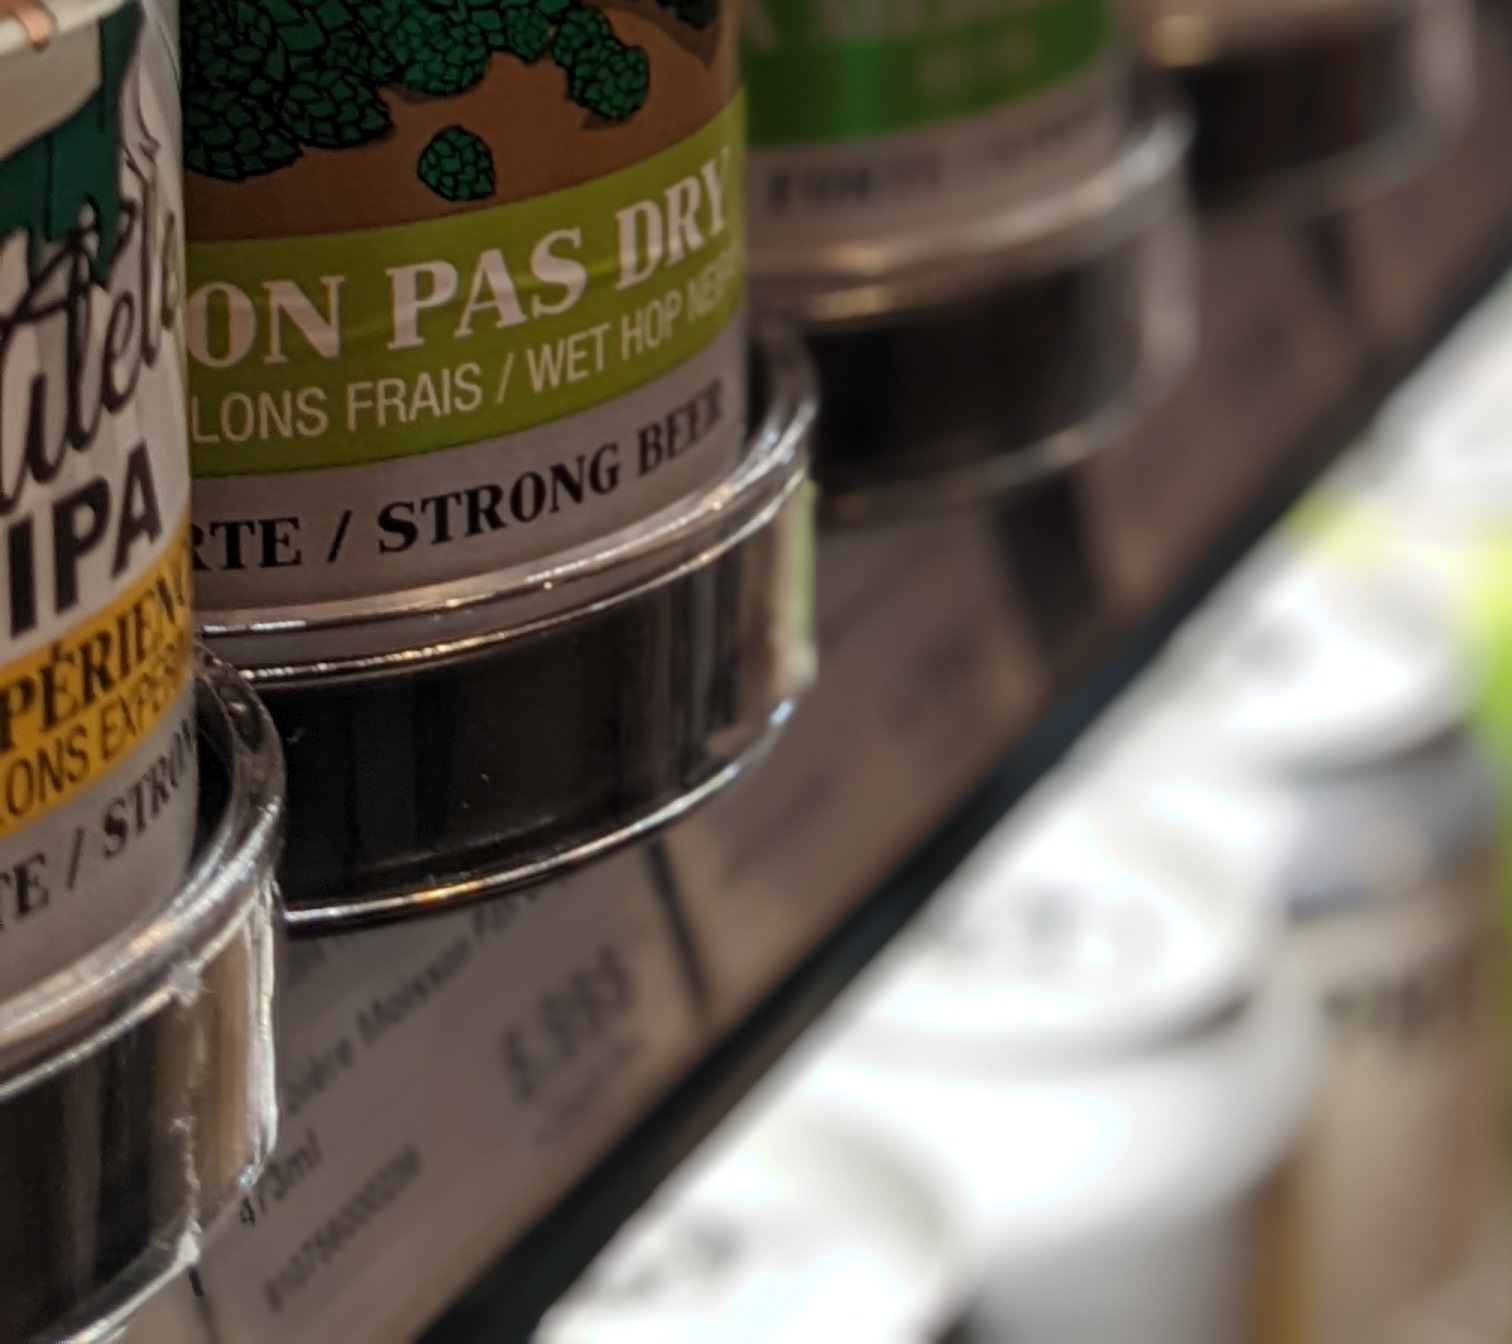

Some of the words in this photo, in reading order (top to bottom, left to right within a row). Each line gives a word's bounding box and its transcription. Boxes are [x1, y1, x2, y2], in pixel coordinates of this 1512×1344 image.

[185, 273, 347, 370] ON
[384, 226, 589, 350] PAS
[614, 145, 730, 291] DRY
[192, 385, 329, 444] LONS
[346, 361, 483, 433] FRAIS
[496, 352, 516, 405] /
[527, 323, 611, 394] WET
[621, 289, 683, 360] HOP
[7, 439, 164, 639] IPA
[327, 510, 353, 564] /
[377, 442, 622, 555] STRONG
[636, 378, 723, 478] BEER
